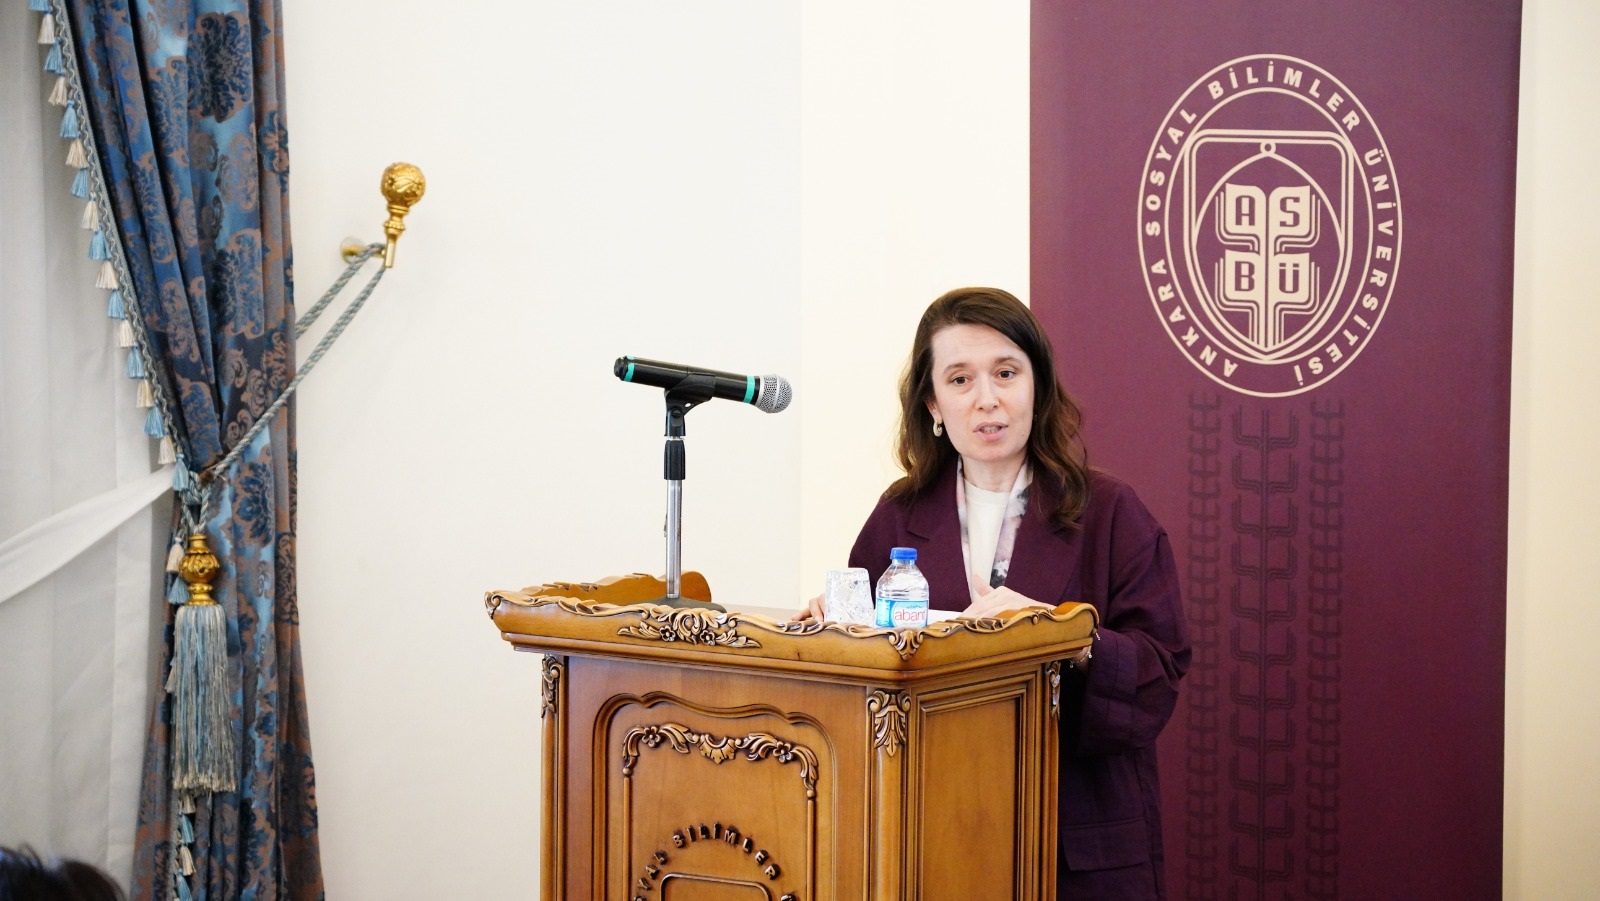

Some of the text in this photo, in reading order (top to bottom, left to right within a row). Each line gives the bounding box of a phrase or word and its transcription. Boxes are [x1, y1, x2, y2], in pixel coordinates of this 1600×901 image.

[1145, 60, 1397, 386] ANKARA SOSYAL BİLİMLER ÜNİVERSİTESİ
